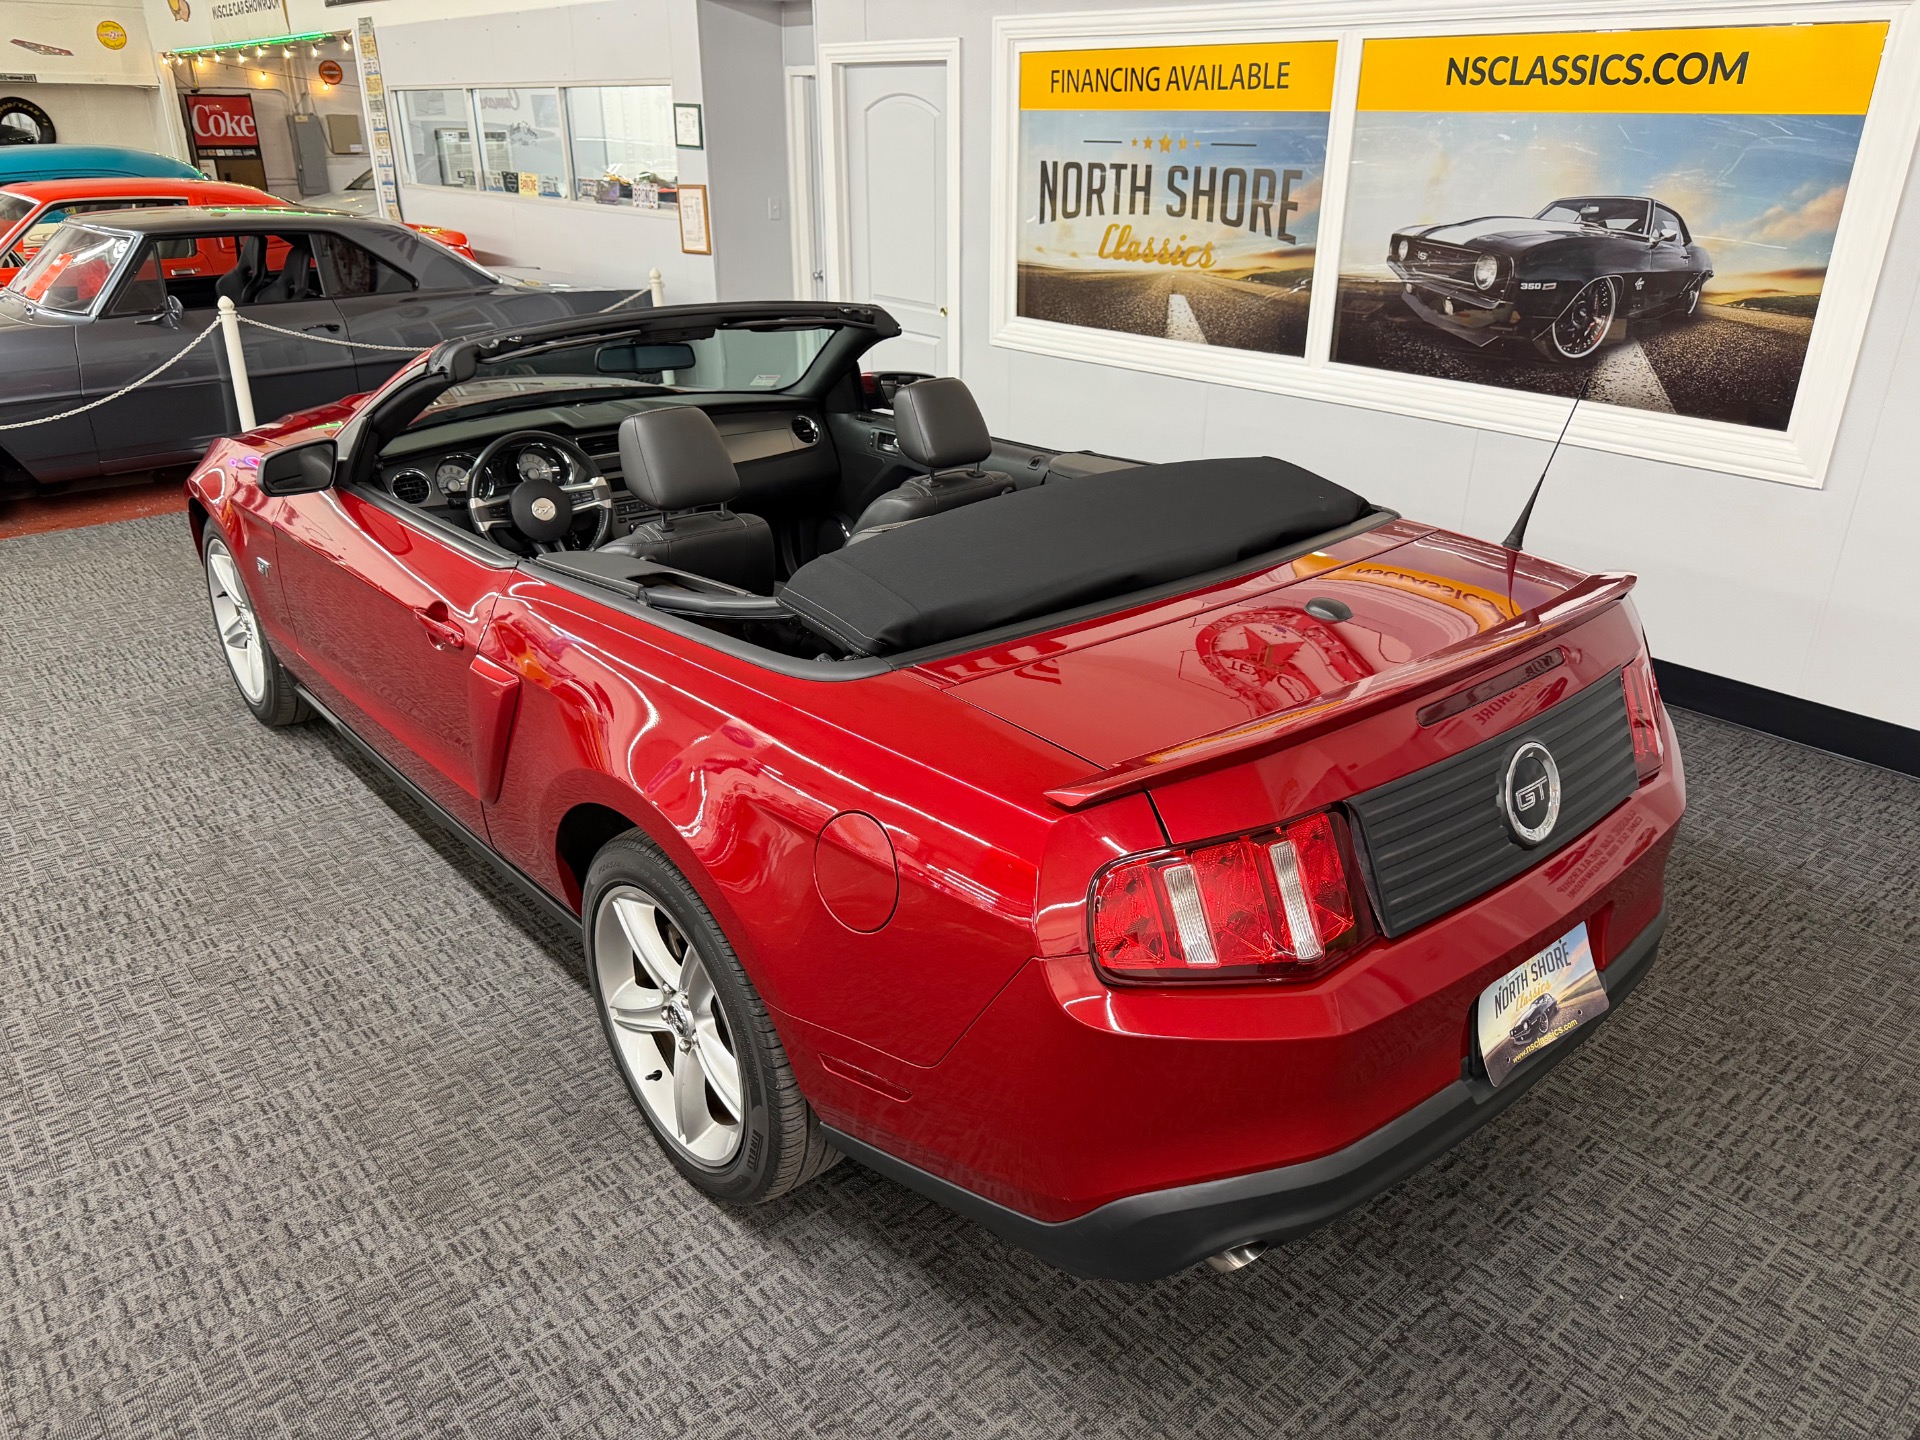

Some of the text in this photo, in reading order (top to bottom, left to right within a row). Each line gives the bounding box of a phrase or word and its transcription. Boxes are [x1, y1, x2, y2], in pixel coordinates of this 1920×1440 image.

[212, 0, 280, 20] MUSCLE CAR SHOWROOM
[1050, 61, 1291, 94] FINANCING AVAILABLE
[1446, 51, 1750, 86] NSCLASSICS.COM
[192, 104, 256, 137] Coke
[1039, 160, 1304, 246] NORTH SHORE
[1098, 223, 1217, 269] Classics
[1520, 282, 1541, 290] 350
[1516, 775, 1547, 811] GT
[1494, 941, 1571, 1019] NORTH SHORE
[1515, 979, 1551, 1012] Classics
[1512, 1019, 1578, 1063] www.nsclassics.com
